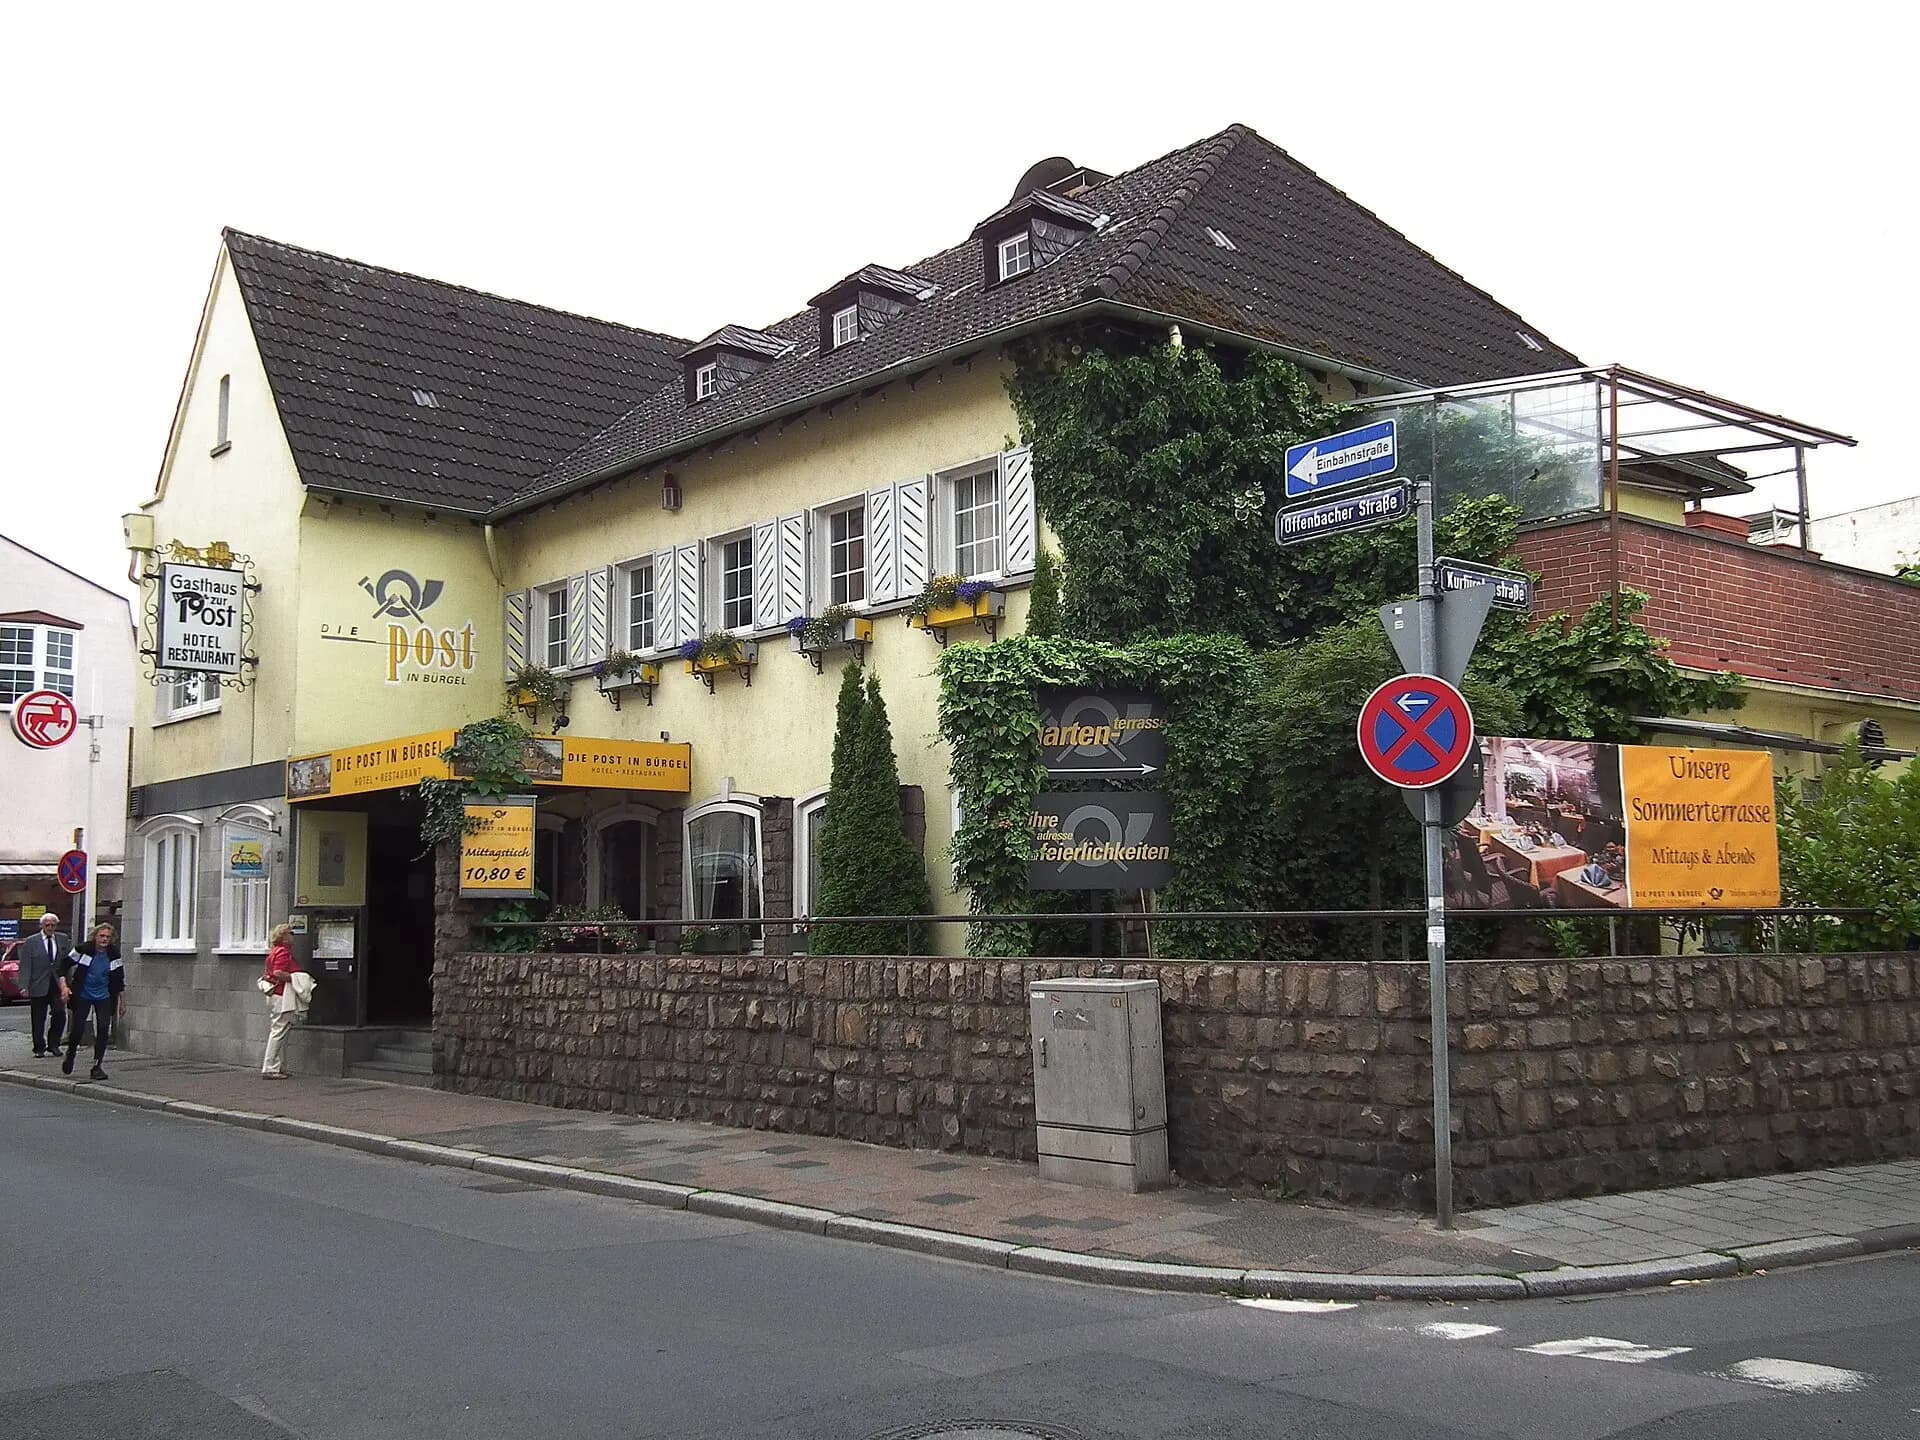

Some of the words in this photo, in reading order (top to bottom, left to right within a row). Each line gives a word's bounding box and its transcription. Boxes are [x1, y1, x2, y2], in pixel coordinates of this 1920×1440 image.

[1316, 442, 1390, 471] Einbahnstraße
[1284, 504, 1354, 534] Offenbacher
[1358, 493, 1398, 516] Straße
[170, 574, 238, 596] Gasthaus
[171, 590, 237, 628] Post
[210, 596, 228, 606] zur
[321, 623, 359, 636] DIE
[183, 632, 222, 649] HOTEL
[168, 647, 236, 666] RESTAURANT
[387, 623, 475, 682] post
[407, 672, 420, 682] IN
[423, 671, 468, 685] BÜRGEL
[336, 756, 352, 773] DIE
[356, 751, 382, 769] POST
[386, 748, 398, 764] IN
[568, 752, 588, 763] DIE
[593, 754, 623, 765] POST
[628, 756, 640, 766] IN
[646, 756, 688, 769] BÜRGEL
[1669, 755, 1731, 781] Unsere
[354, 775, 374, 787] HOTEL
[380, 767, 422, 783] RESTAURANT
[591, 767, 613, 775] HOTEL
[622, 769, 667, 777] RESTAURANT
[1028, 810, 1059, 828] ihre
[1632, 797, 1771, 823] Sommerterrasse
[1036, 831, 1073, 841] adresse
[464, 847, 530, 862] Mittagstisch
[1039, 841, 1170, 861] feierlichkeiten
[1651, 846, 1700, 870] Mittags
[1701, 848, 1712, 865] &
[1715, 842, 1756, 866] Abends
[465, 867, 511, 883] 10,80
[514, 867, 527, 881] €
